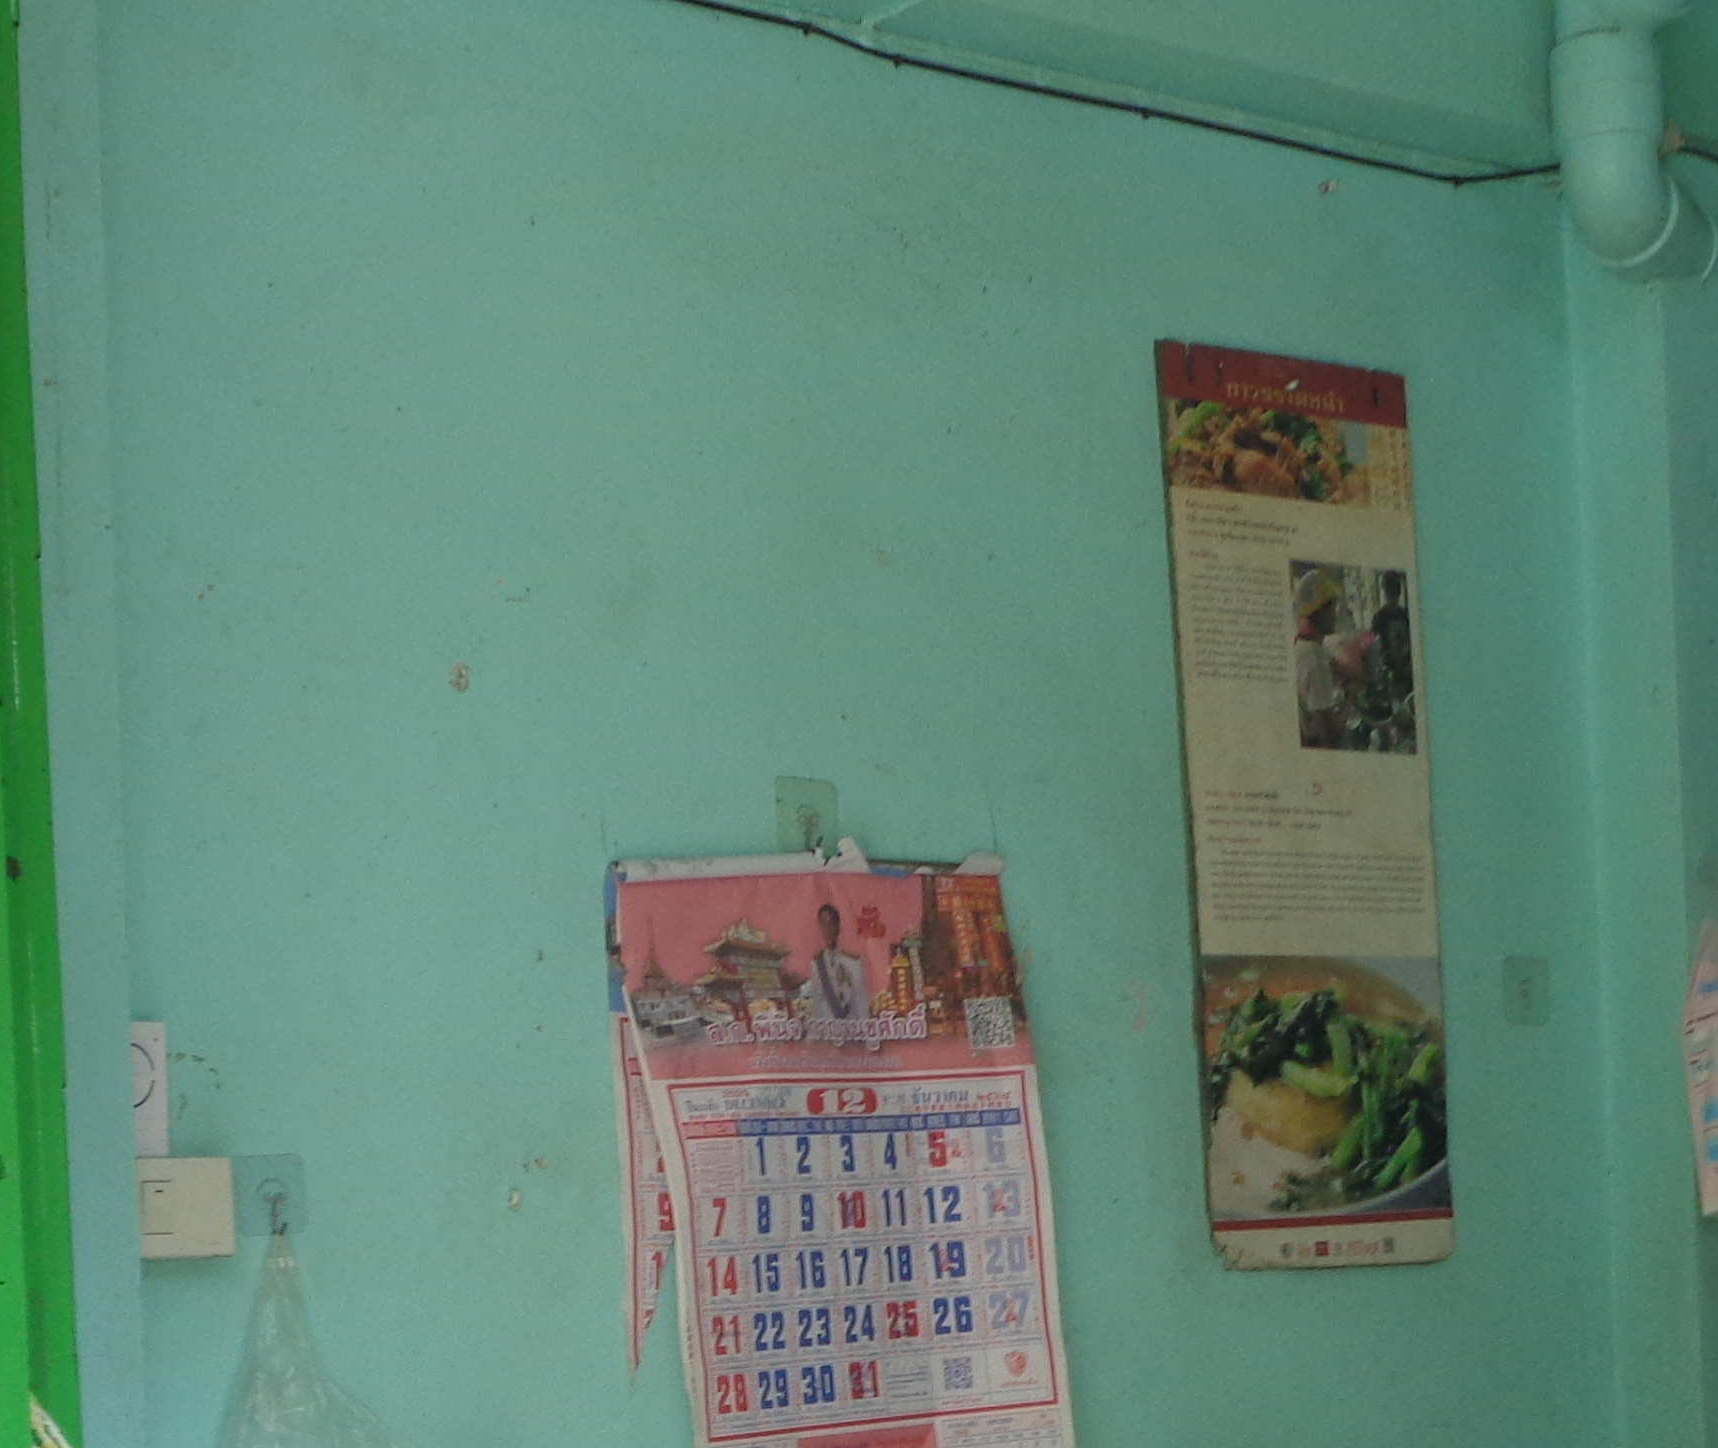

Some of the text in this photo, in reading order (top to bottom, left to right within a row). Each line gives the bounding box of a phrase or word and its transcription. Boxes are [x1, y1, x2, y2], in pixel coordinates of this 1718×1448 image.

[819, 1089, 868, 1114] 12
[756, 1127, 1006, 1177] 1 2 3 4 5 6
[713, 1180, 1023, 1237] 7 8 9 10 11 12 13
[707, 1236, 1027, 1297] 14 15 16 17 18 19 20
[711, 1291, 1031, 1356] 21 22 23 24 25 26 27
[717, 1360, 880, 1415] 28 29 30 31
